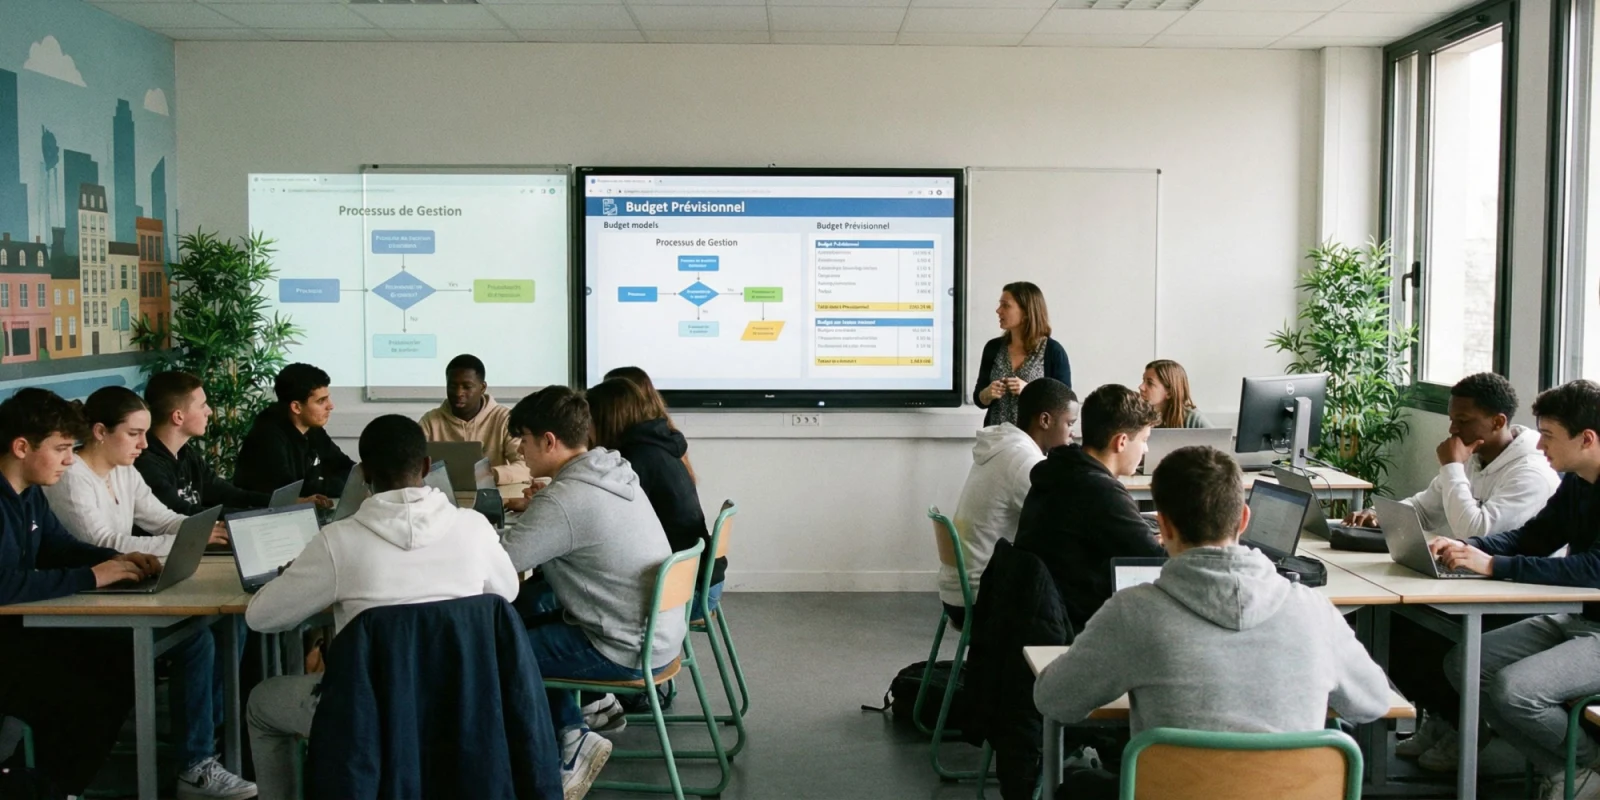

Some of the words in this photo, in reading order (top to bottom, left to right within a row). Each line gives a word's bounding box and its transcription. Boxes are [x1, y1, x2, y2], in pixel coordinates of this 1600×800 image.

[339, 205, 396, 216] Processus
[399, 205, 413, 216] de
[417, 205, 462, 217] Gestion
[626, 201, 668, 215] Budget
[671, 200, 745, 213] Prévisionnel
[603, 221, 630, 231] Budget
[632, 221, 659, 229] models
[816, 222, 843, 231] Budget
[845, 221, 890, 230] Prévisionnel
[656, 238, 694, 247] Processus
[696, 238, 706, 247] de
[708, 238, 738, 247] Gestion
